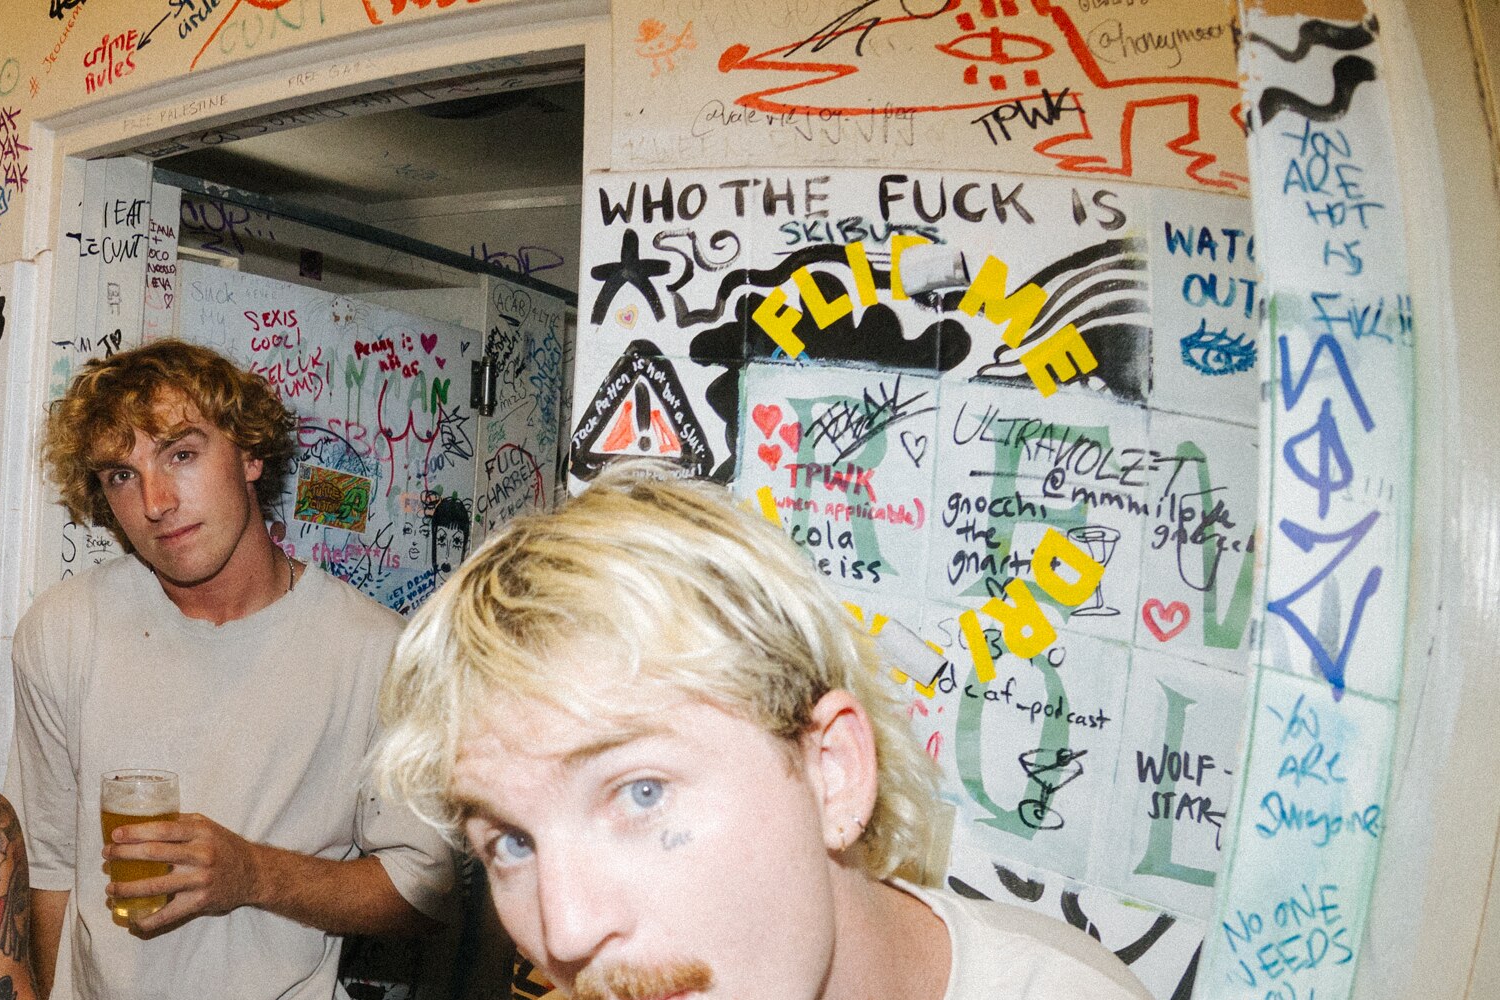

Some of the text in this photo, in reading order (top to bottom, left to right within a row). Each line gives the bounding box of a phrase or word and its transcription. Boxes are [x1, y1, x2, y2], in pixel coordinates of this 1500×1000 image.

[3, 163, 29, 192] YAK
[114, 199, 146, 228] EAT
[598, 173, 1127, 229] WHO THE FUCK IS
[102, 234, 145, 264] CUNT
[572, 416, 599, 449] Jack
[784, 463, 877, 503] TPWK
[943, 491, 1048, 529] gnocchi
[788, 519, 854, 549] cola
[956, 519, 1002, 549] the
[1275, 882, 1344, 930] ONE
